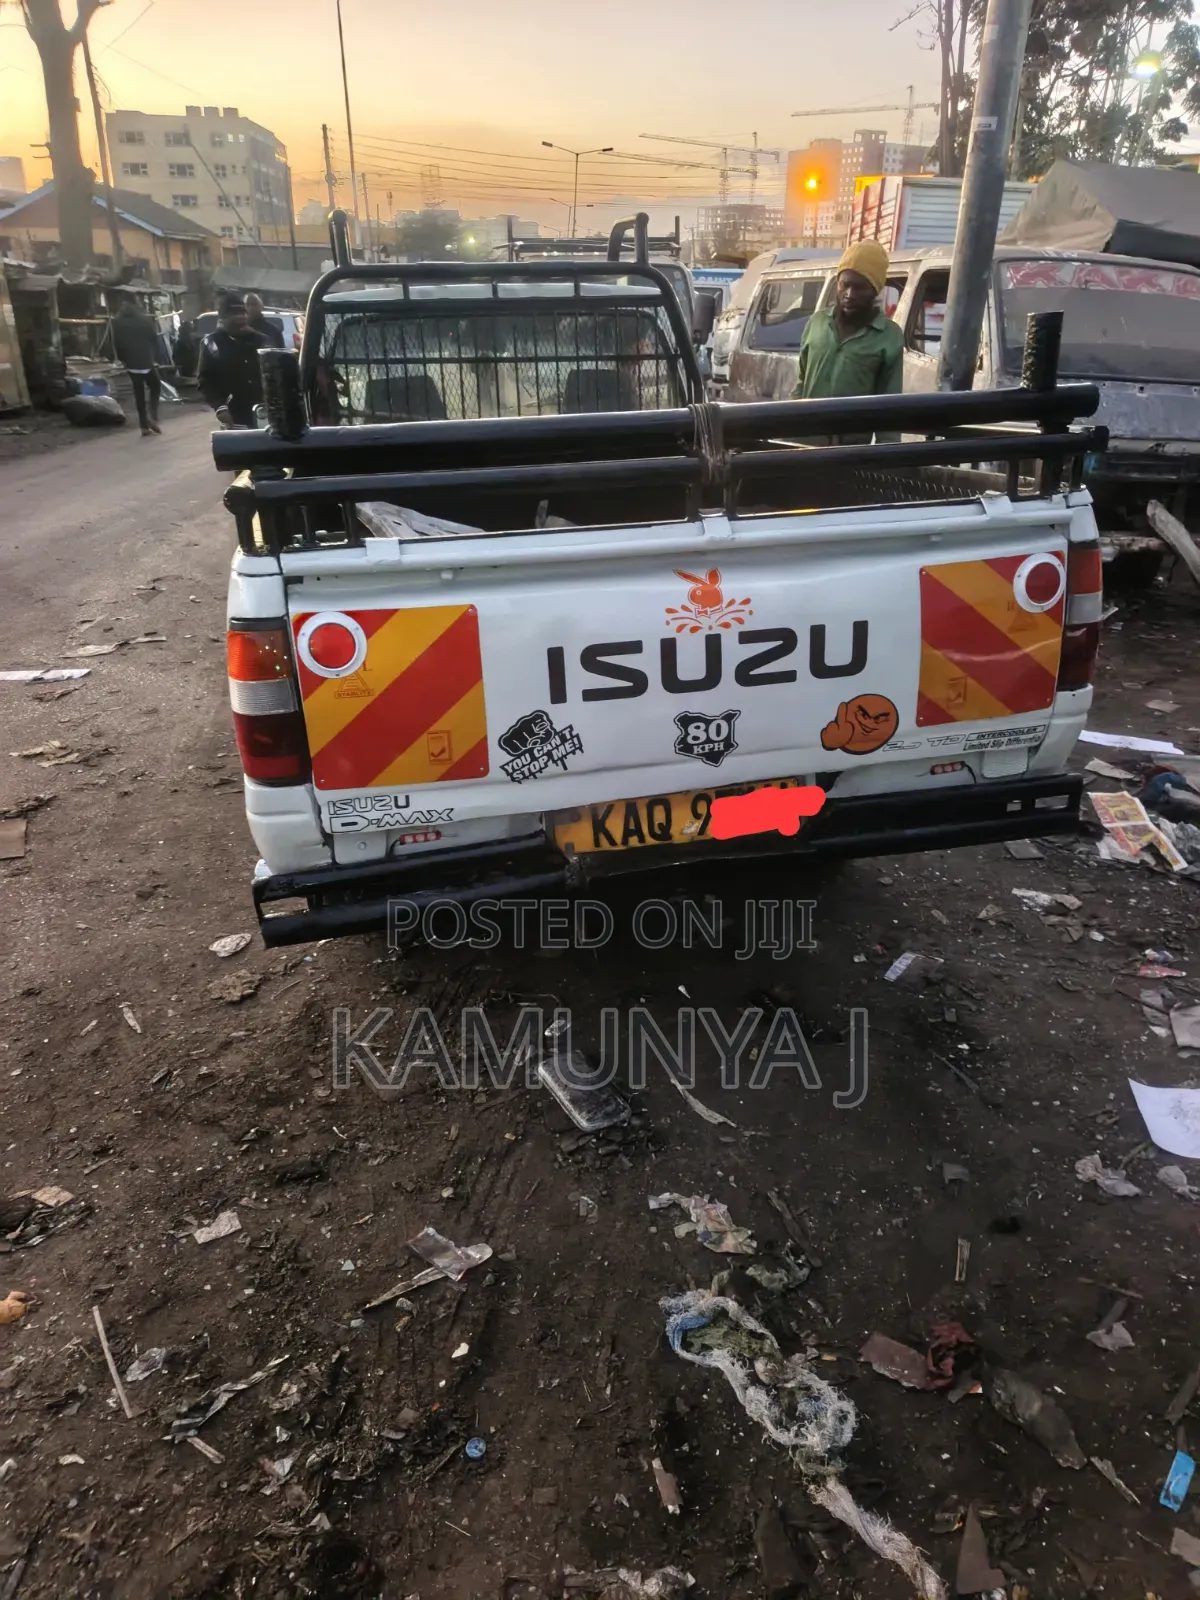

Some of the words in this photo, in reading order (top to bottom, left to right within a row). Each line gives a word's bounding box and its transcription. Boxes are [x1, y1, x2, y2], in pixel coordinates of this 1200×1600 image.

[547, 620, 868, 704] ISUZU
[686, 719, 729, 745] 80
[963, 739, 990, 751] Limited
[990, 738, 1004, 748] Slip
[976, 727, 1038, 741] INTERCOOLER
[504, 753, 531, 773] YOU
[533, 728, 572, 757] CAN'T
[513, 755, 549, 780] STOP
[552, 735, 580, 760] ME!
[693, 741, 725, 755] KPH
[328, 795, 410, 815] ISUZU
[329, 808, 455, 833] D-MAX
[590, 797, 673, 848] KAQ
